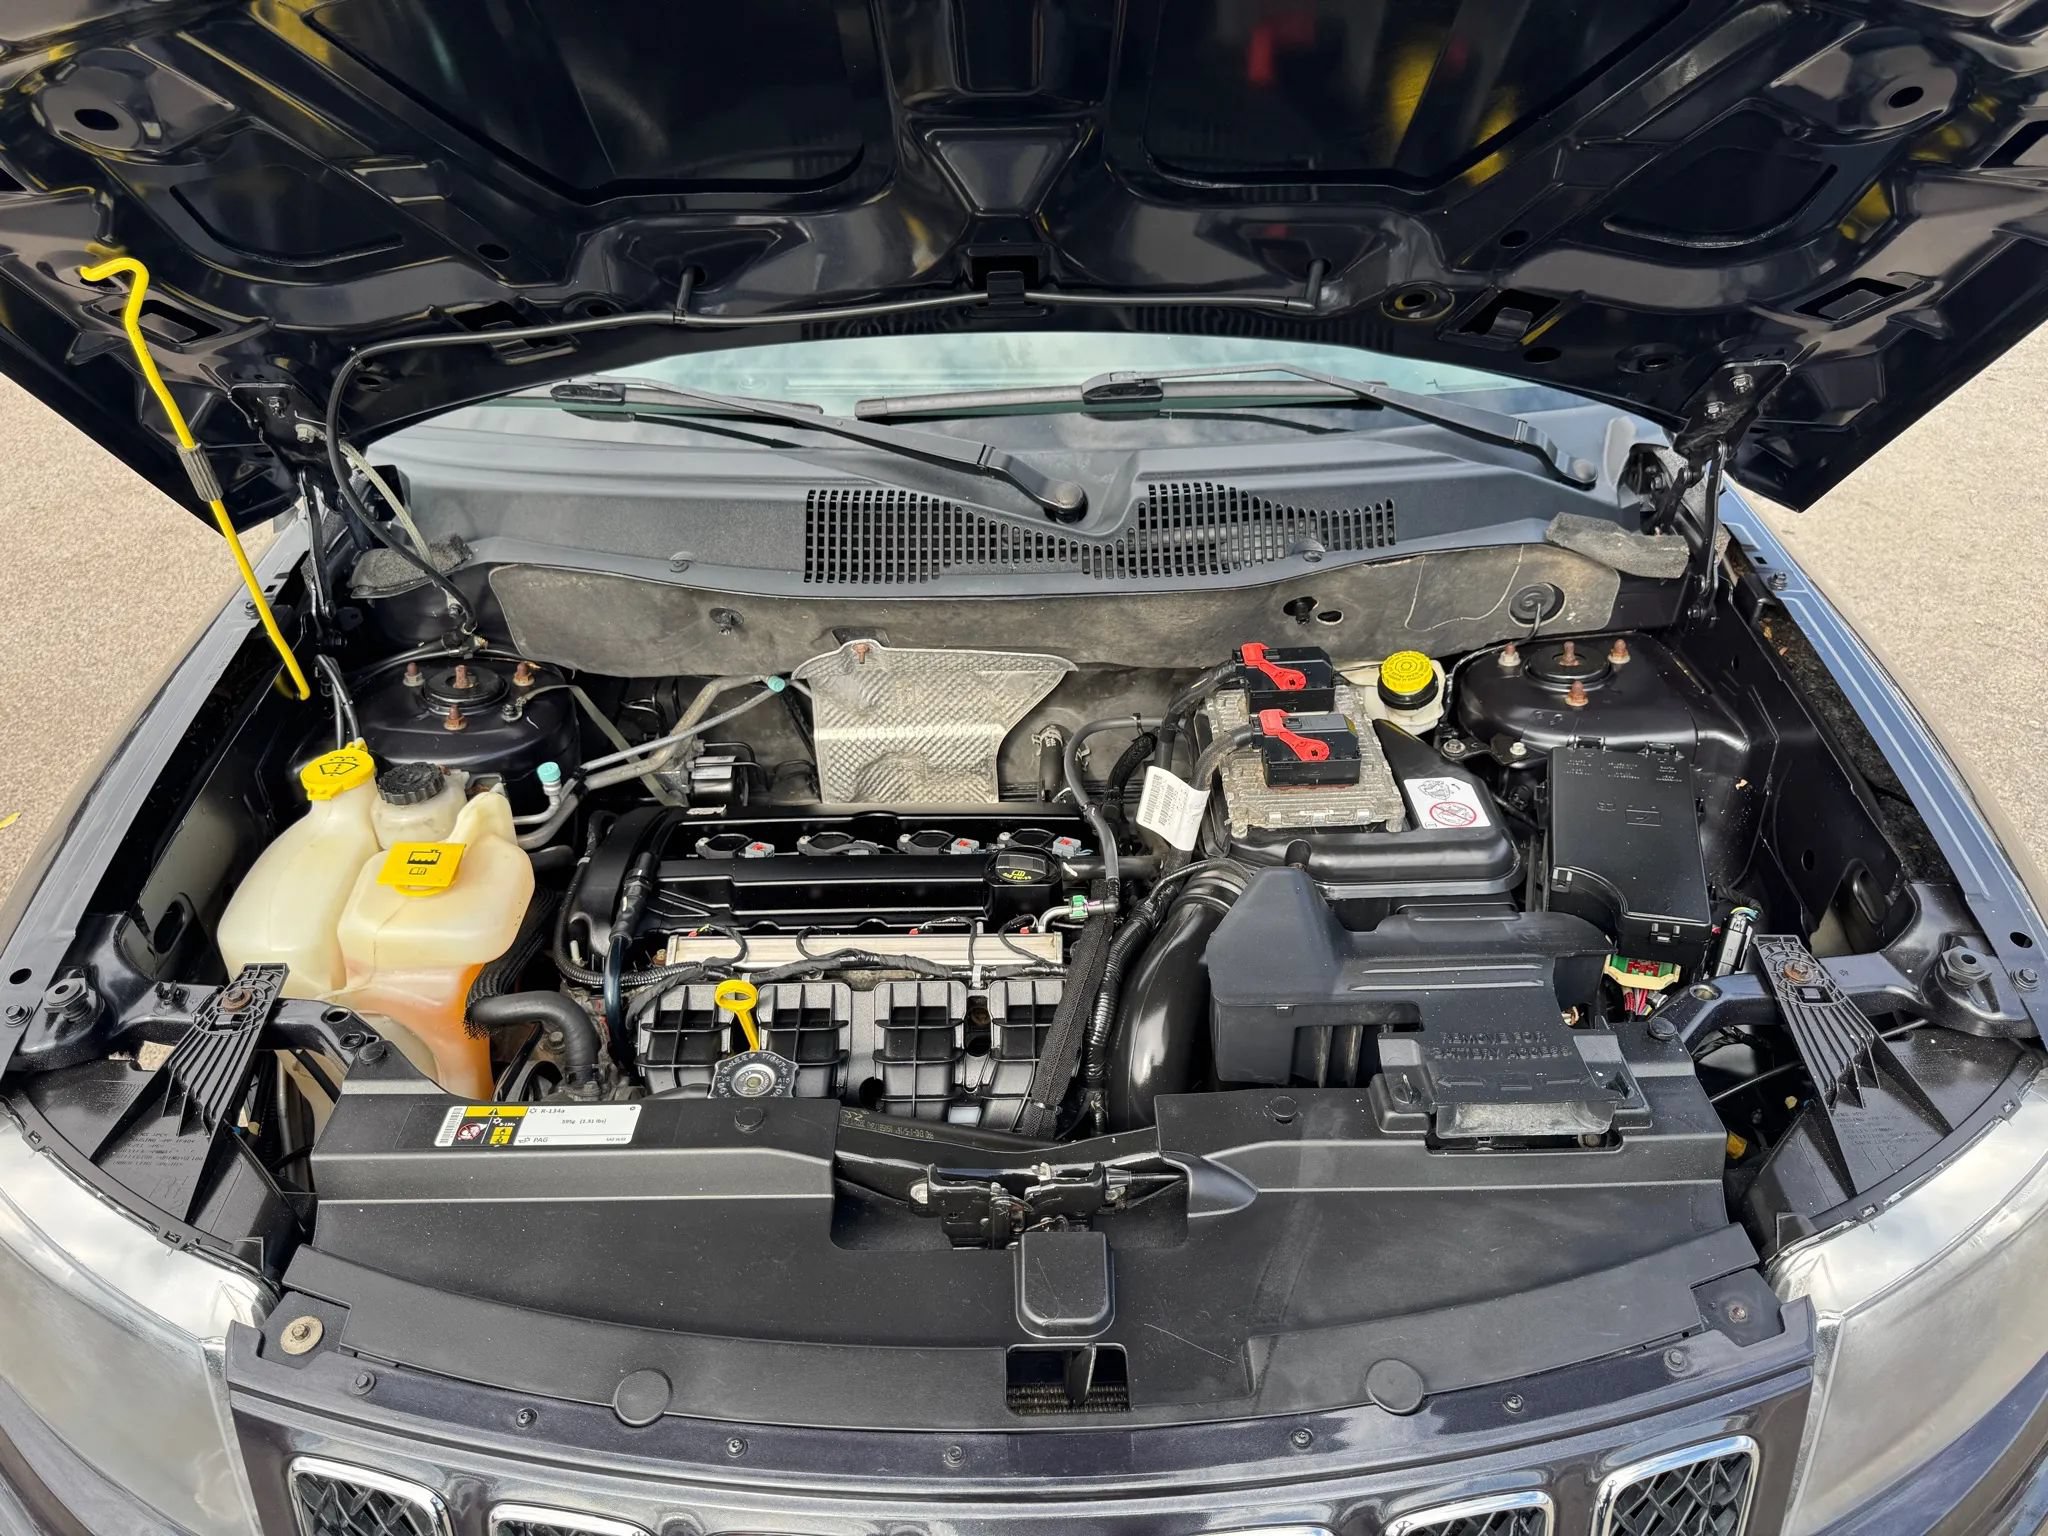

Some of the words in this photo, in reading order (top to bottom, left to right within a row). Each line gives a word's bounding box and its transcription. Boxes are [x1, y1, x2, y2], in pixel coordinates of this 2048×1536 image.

[1440, 1031, 1509, 1045] REMOVE
[1513, 1030, 1548, 1043] FOR
[1431, 1046, 1501, 1060] BATTERY
[1507, 1045, 1570, 1060] ACCESS
